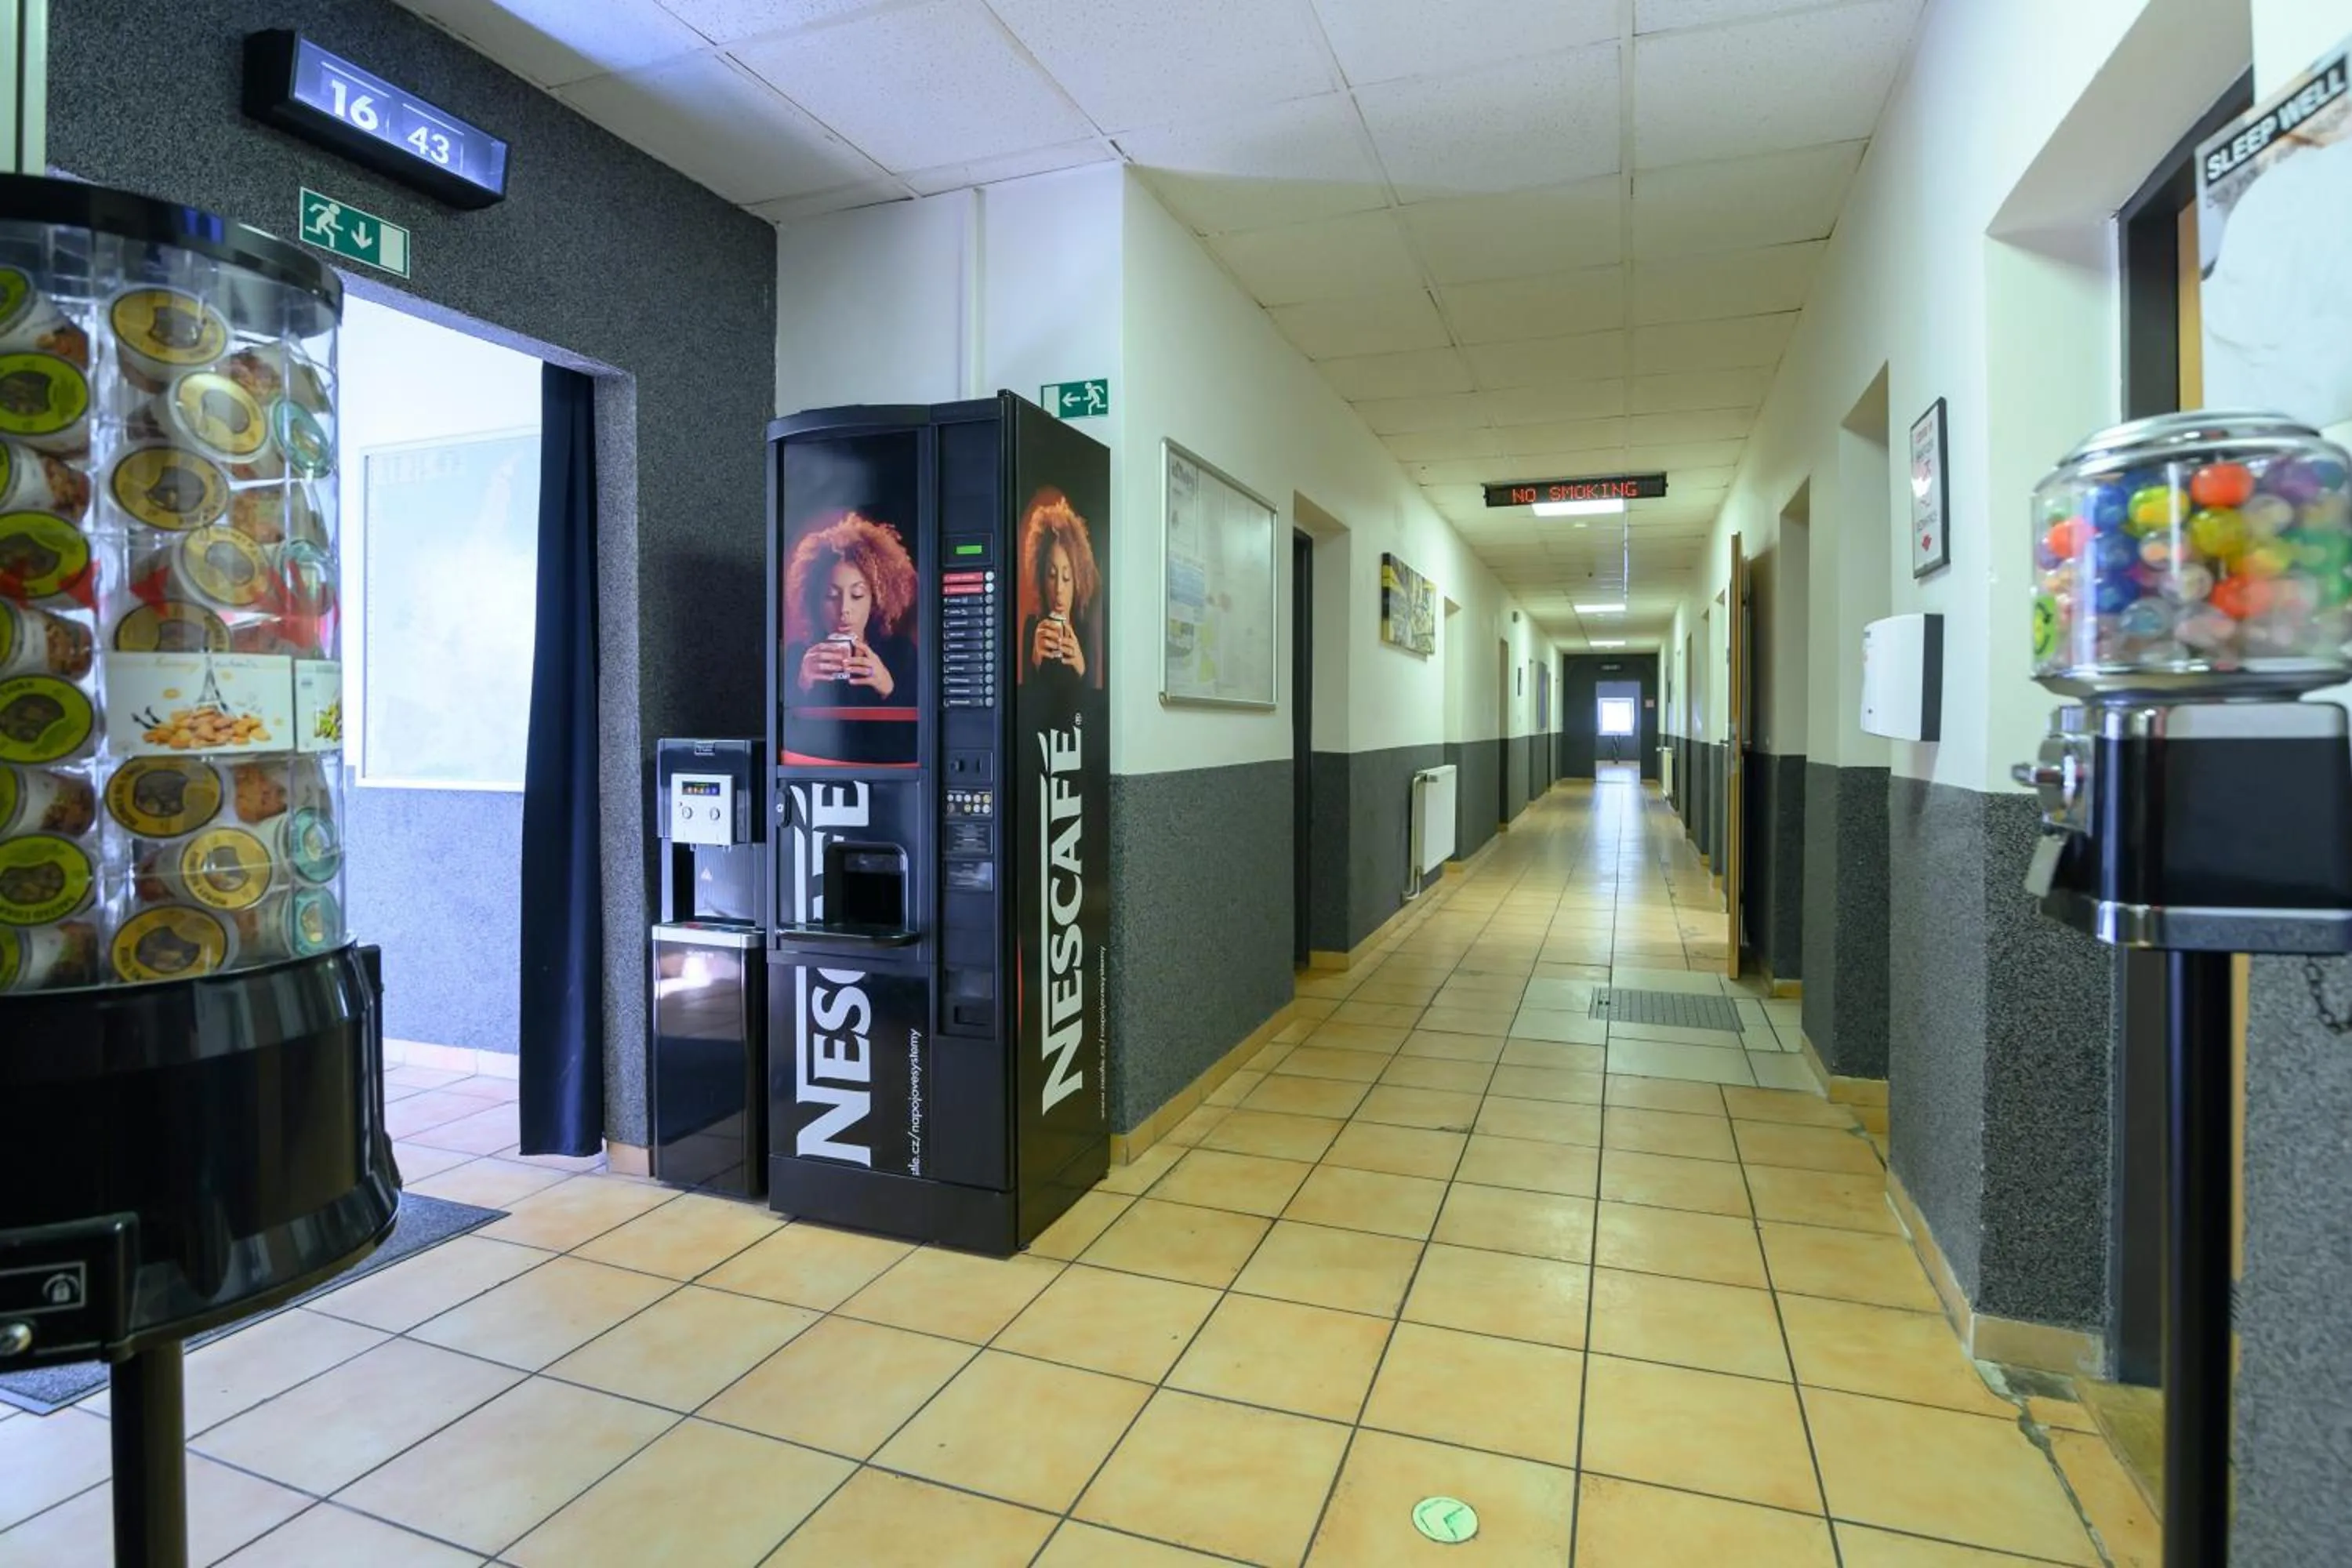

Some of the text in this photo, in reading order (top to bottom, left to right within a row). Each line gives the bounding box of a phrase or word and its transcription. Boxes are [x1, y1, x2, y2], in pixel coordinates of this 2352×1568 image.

[331, 79, 450, 164] 16 43
[2206, 66, 2346, 180] SLEEP WELL
[1512, 481, 1639, 503] NO SMOKING
[1037, 725, 1083, 1116] NESCAFÉ
